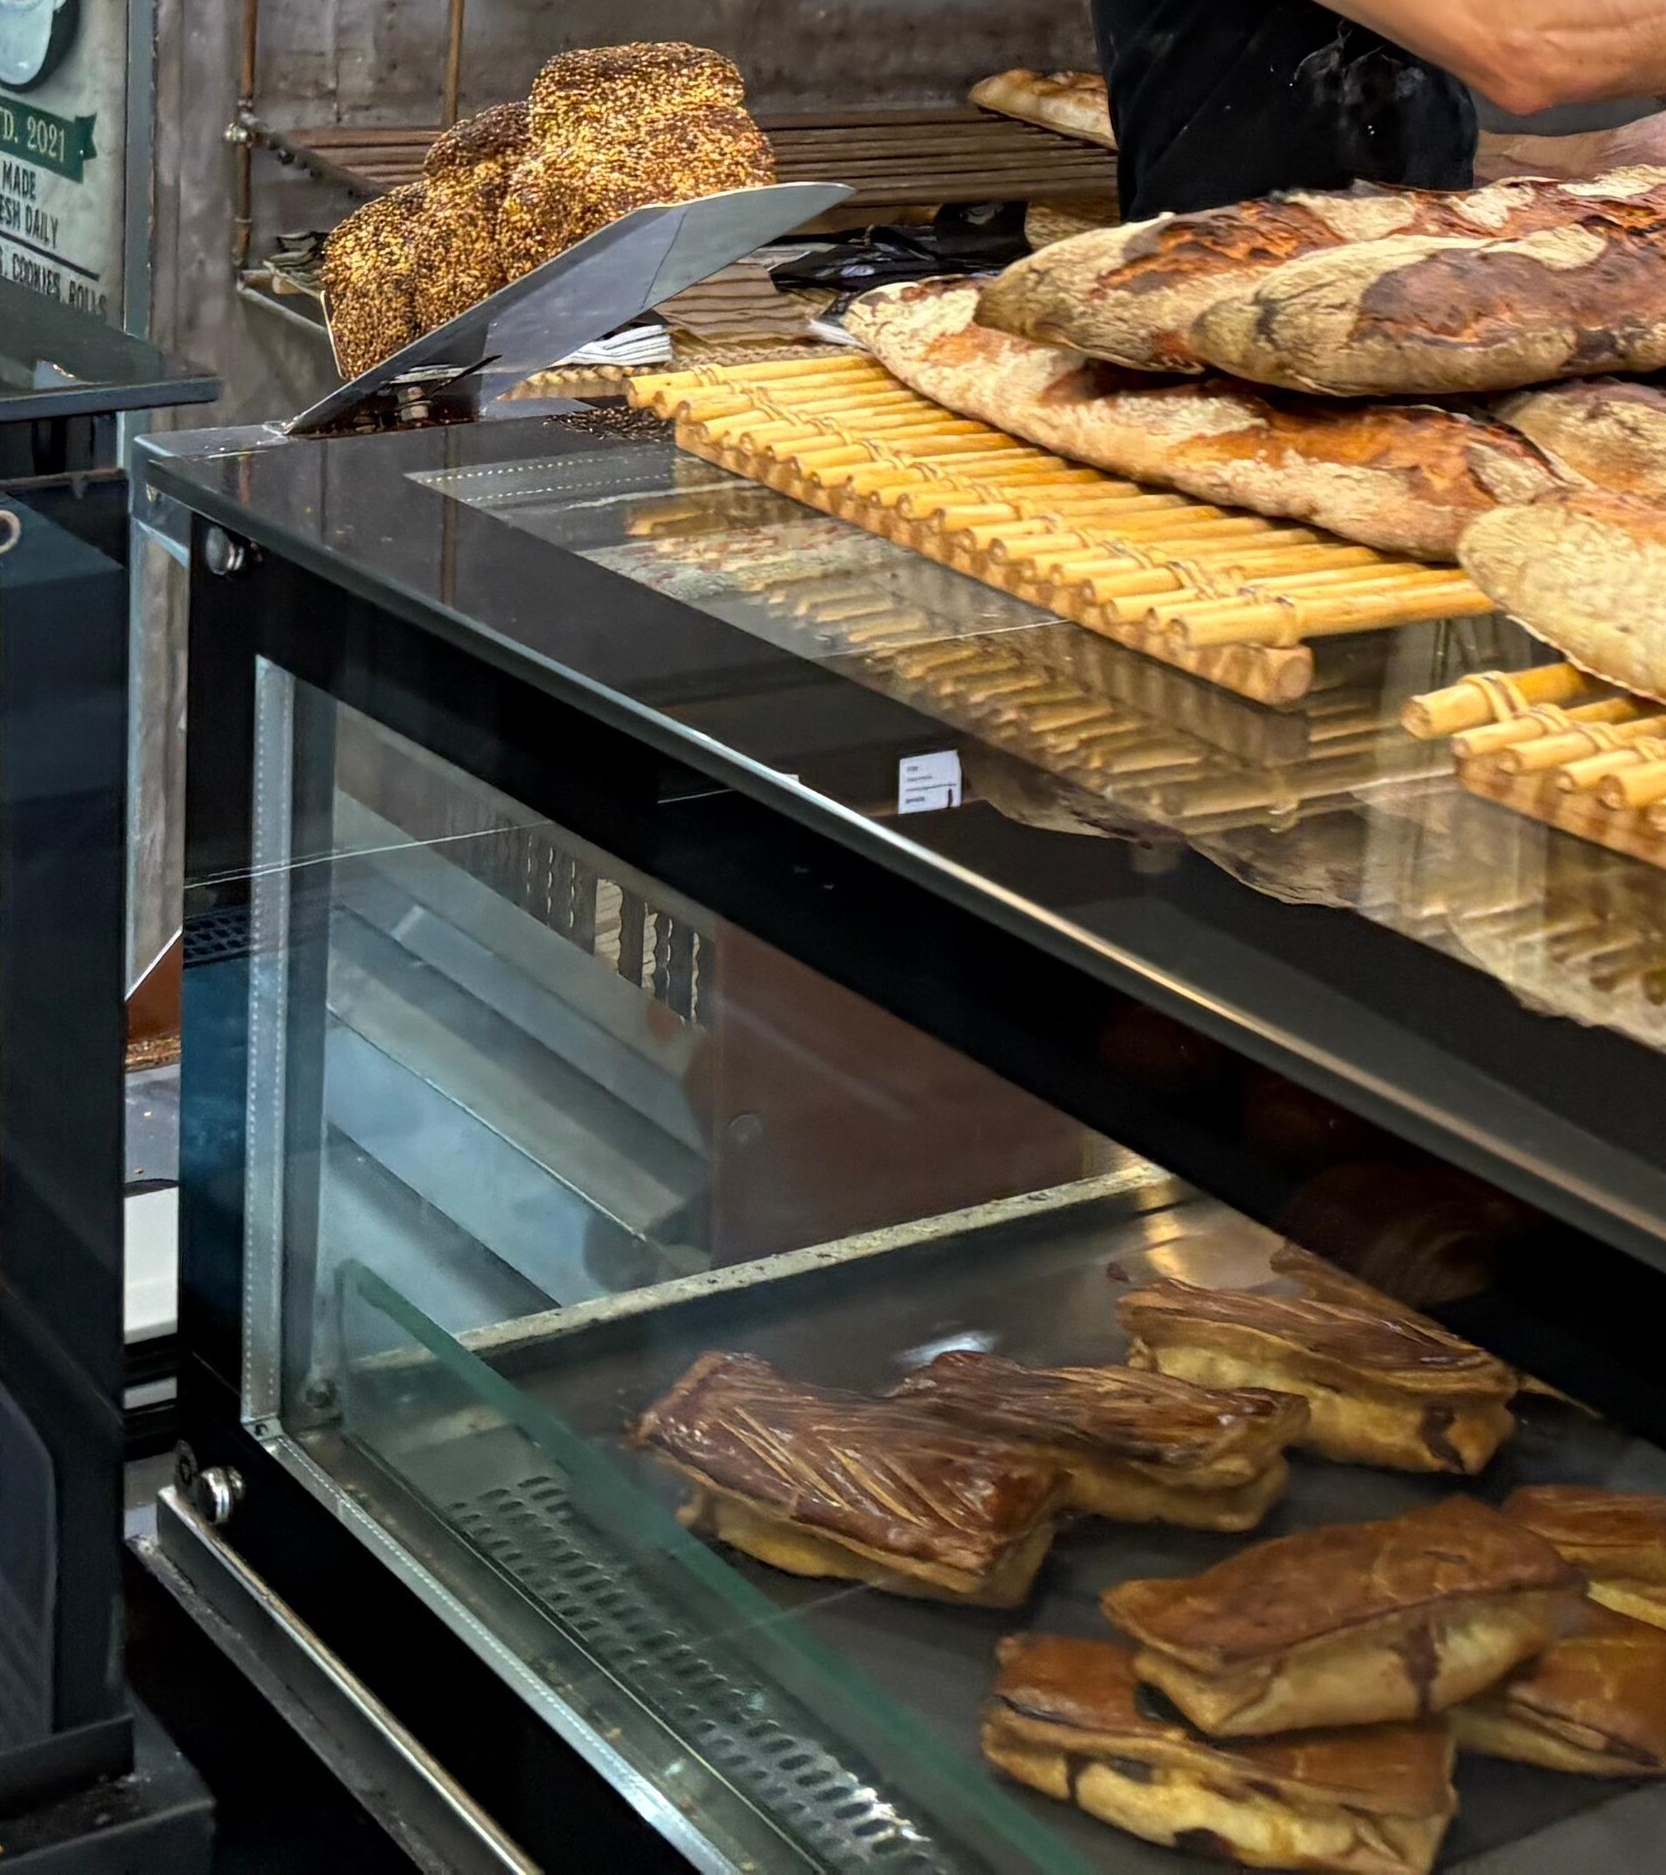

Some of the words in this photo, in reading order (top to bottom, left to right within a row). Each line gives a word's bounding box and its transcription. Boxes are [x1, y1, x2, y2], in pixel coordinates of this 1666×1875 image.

[26, 116, 65, 164] 2021
[1, 160, 37, 202] MADE
[25, 204, 59, 250] DAILY
